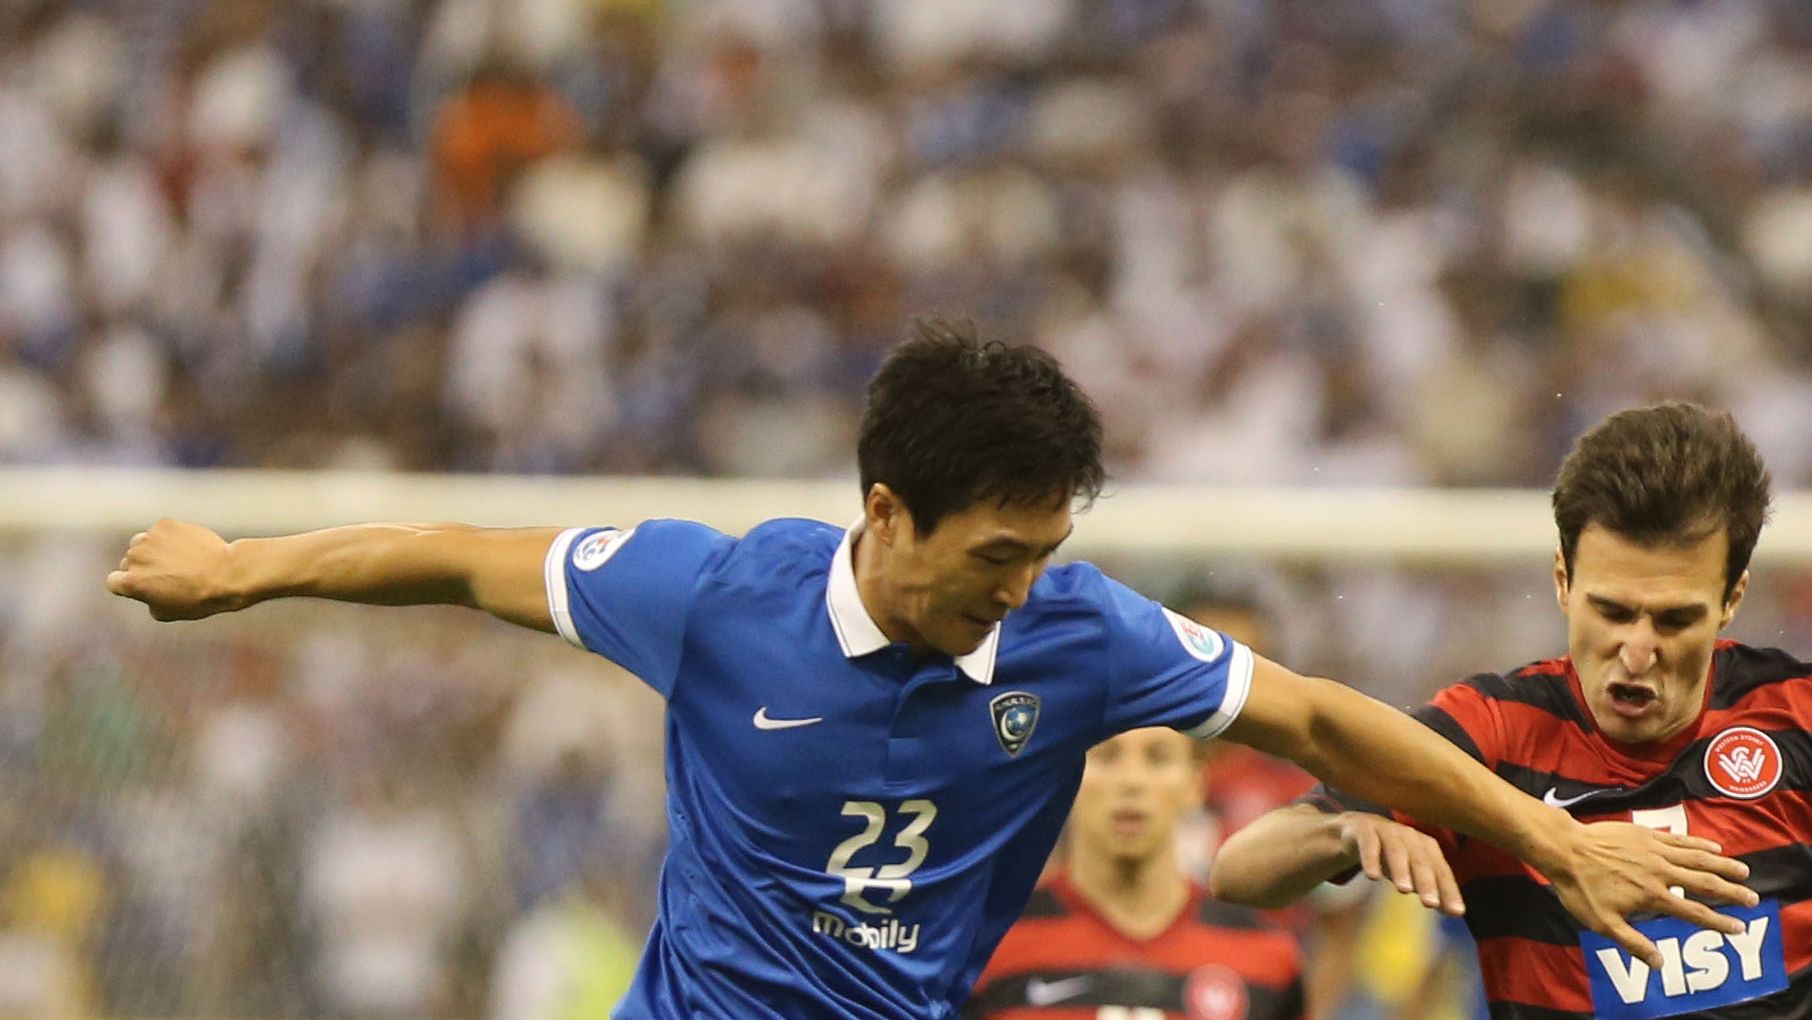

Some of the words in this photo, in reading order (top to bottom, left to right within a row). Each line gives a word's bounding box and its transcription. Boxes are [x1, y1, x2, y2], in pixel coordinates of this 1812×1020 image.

[826, 799, 938, 880] 23
[813, 910, 920, 953] mobily
[1595, 916, 1769, 1004] VISY
